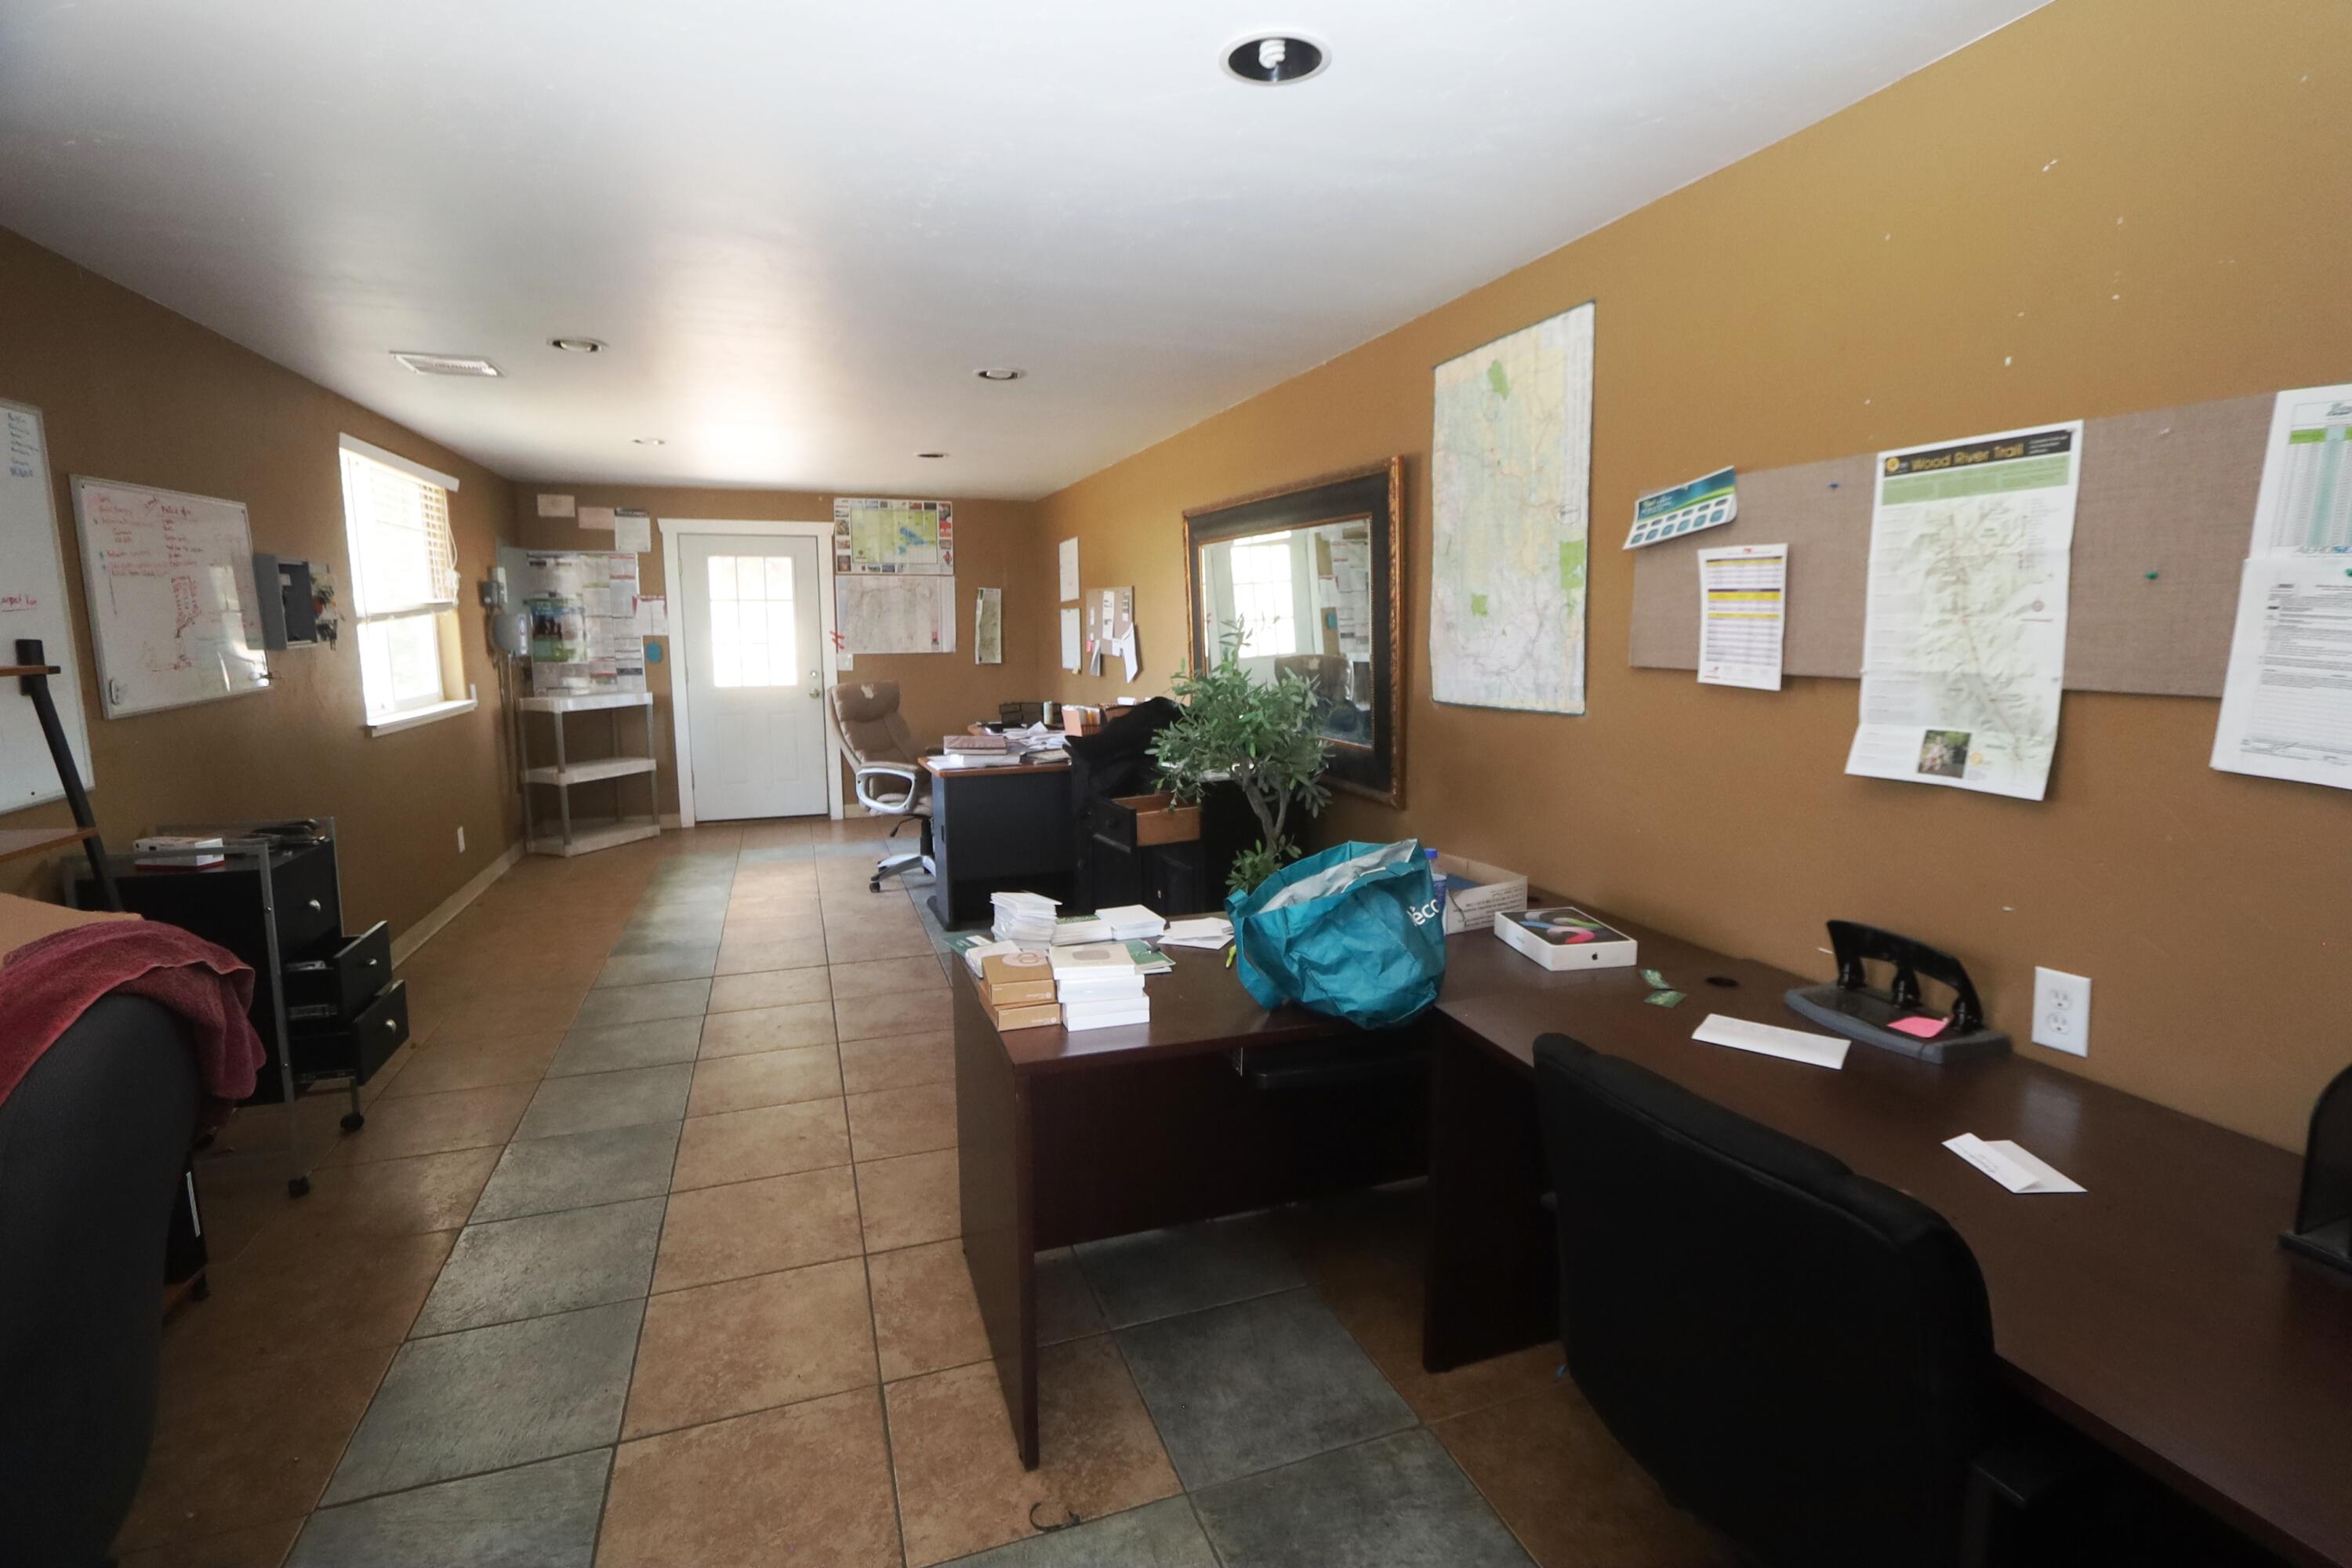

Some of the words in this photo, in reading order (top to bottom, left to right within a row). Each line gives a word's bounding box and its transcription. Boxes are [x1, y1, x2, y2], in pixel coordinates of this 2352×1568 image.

[1911, 455, 1951, 470] Wood
[1954, 451, 1990, 464] River
[1993, 443, 2024, 459] Trail
